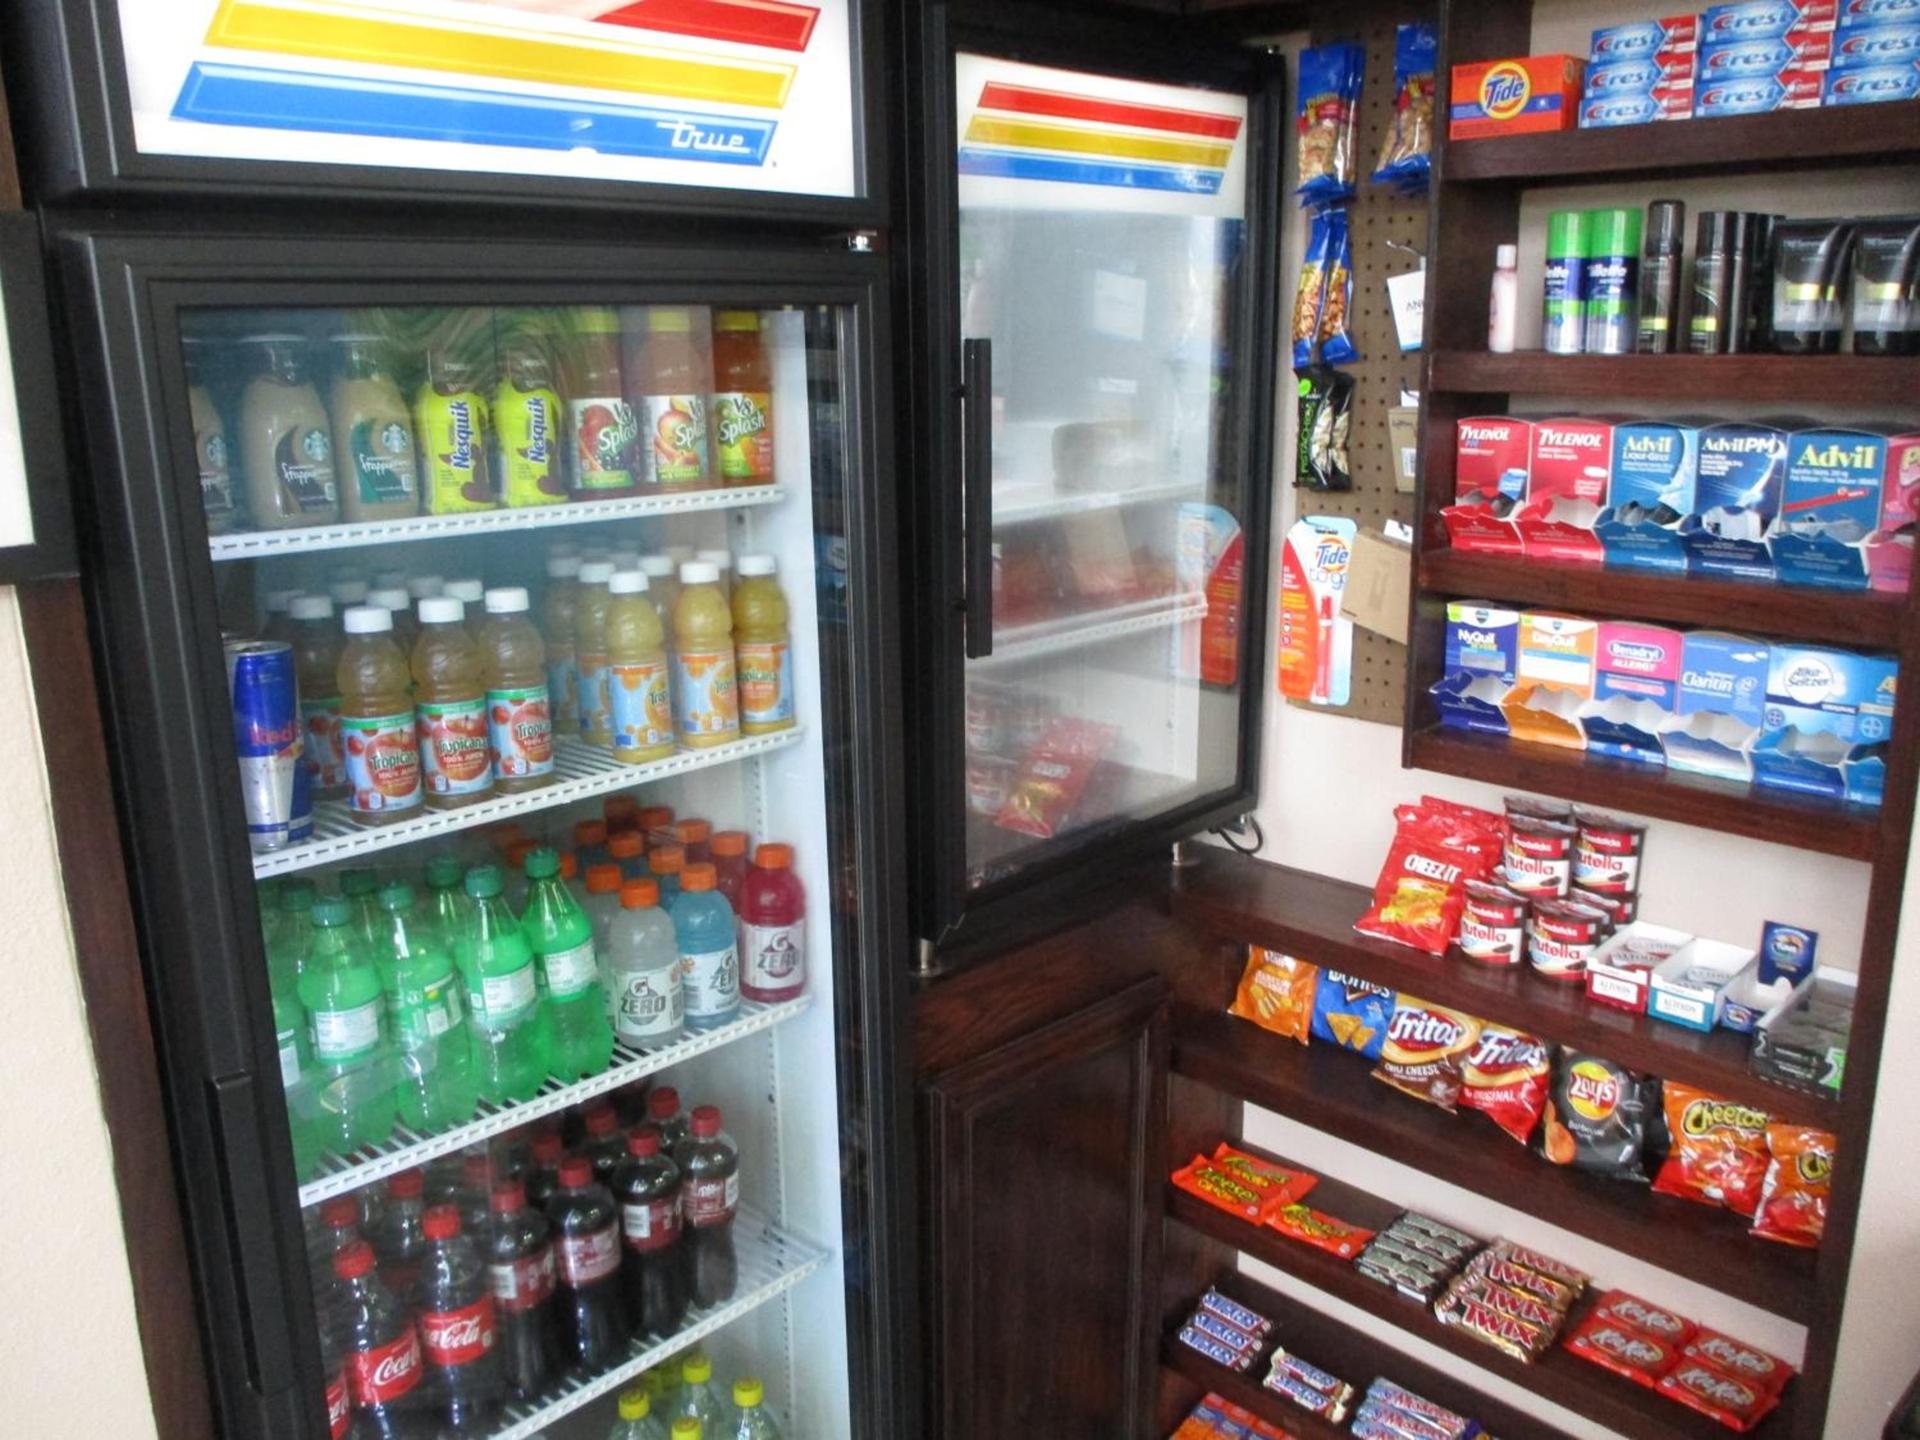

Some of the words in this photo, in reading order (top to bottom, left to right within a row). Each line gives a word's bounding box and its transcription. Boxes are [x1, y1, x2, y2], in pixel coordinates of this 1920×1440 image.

[1712, 10, 1787, 31] Crest
[1596, 33, 1660, 53] Crest
[1708, 46, 1785, 67] Crest
[1591, 68, 1656, 88] Crest
[1833, 74, 1914, 94] Crest
[1485, 74, 1525, 111] Tide
[1702, 84, 1777, 105] Crest
[1586, 101, 1651, 119] Crest
[449, 399, 475, 470] Nesquik
[527, 396, 548, 464] Nesquik
[717, 412, 768, 446] Splash
[1538, 428, 1604, 448] TYLENOL
[1624, 435, 1672, 453] Advil
[1797, 445, 1877, 470] Advil
[1316, 543, 1350, 567] Tide
[1458, 628, 1497, 648] NyQuil
[1682, 671, 1734, 692] Claritin
[618, 996, 666, 1016] ZERO
[1387, 1002, 1463, 1047] Fritos
[1466, 1030, 1548, 1068] Fritos
[1405, 1063, 1442, 1077] CHEESE
[1473, 1088, 1516, 1103] ORIGINAL
[1681, 1100, 1768, 1138] Cheetos
[1489, 1259, 1558, 1300] TWIX
[1484, 1284, 1552, 1326] TWIX
[1462, 1303, 1538, 1349] TWIX
